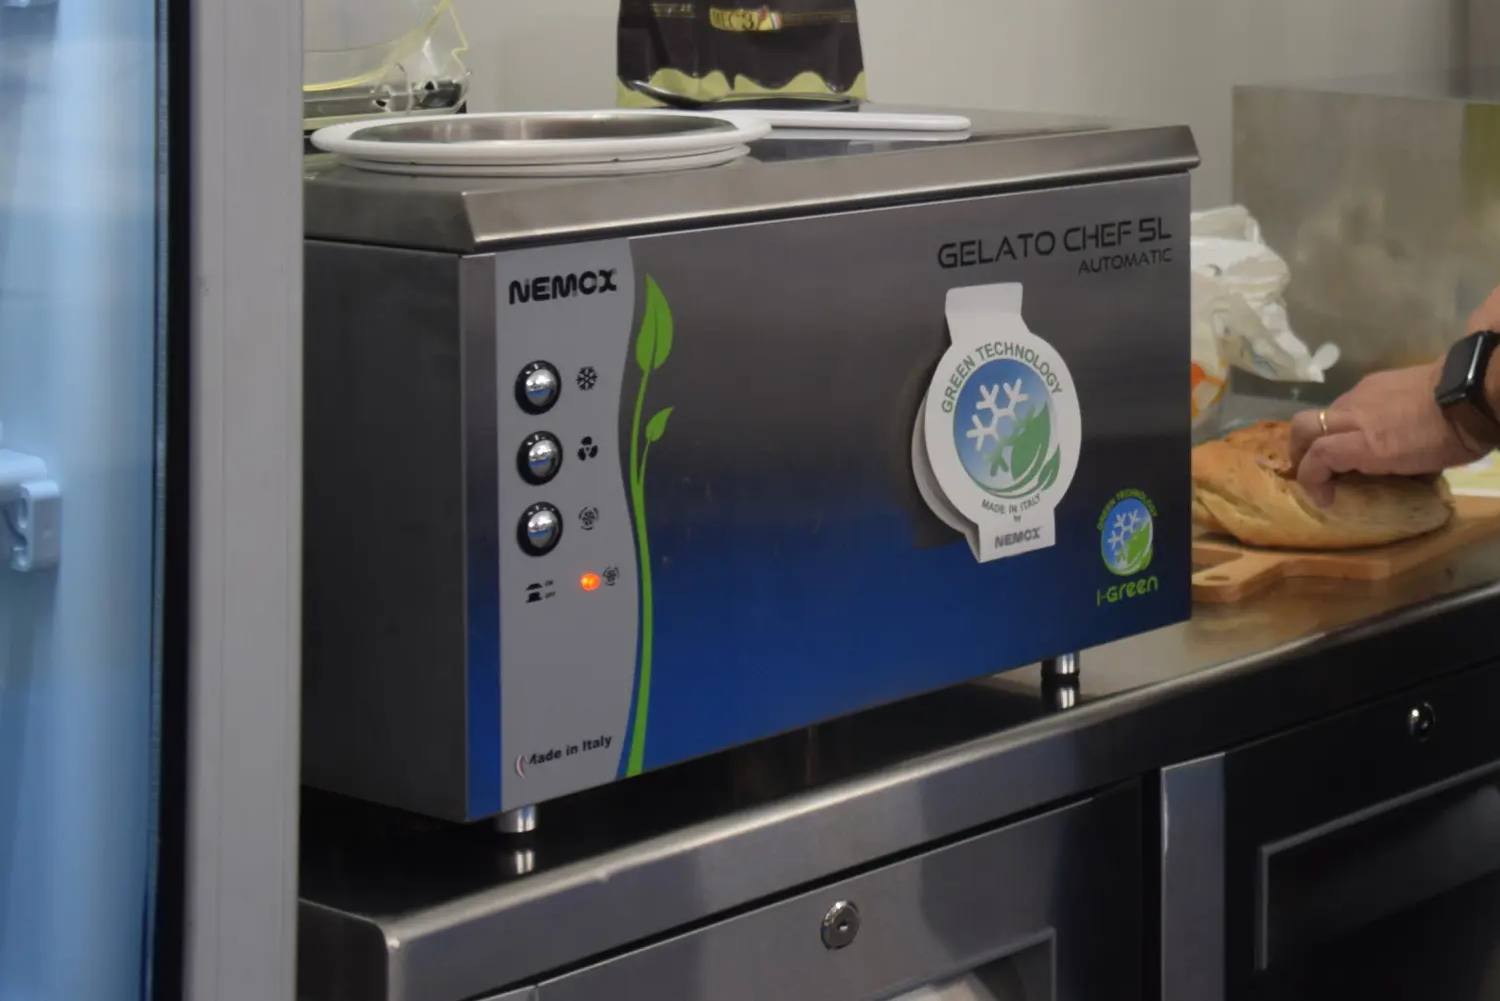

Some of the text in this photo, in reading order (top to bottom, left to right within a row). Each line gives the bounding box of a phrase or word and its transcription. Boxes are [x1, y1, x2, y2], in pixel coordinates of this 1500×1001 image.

[937, 217, 1173, 269] GELATO CHEF 5L
[1078, 248, 1173, 275] AUTOMATIC
[509, 268, 617, 305] NEMOX
[941, 341, 1063, 414] GREEN TECHNOLOGY
[982, 493, 1041, 514] MADE IN ITALY
[994, 526, 1041, 549] NEMOX
[565, 744, 578, 756] in
[582, 735, 612, 751] Italy
